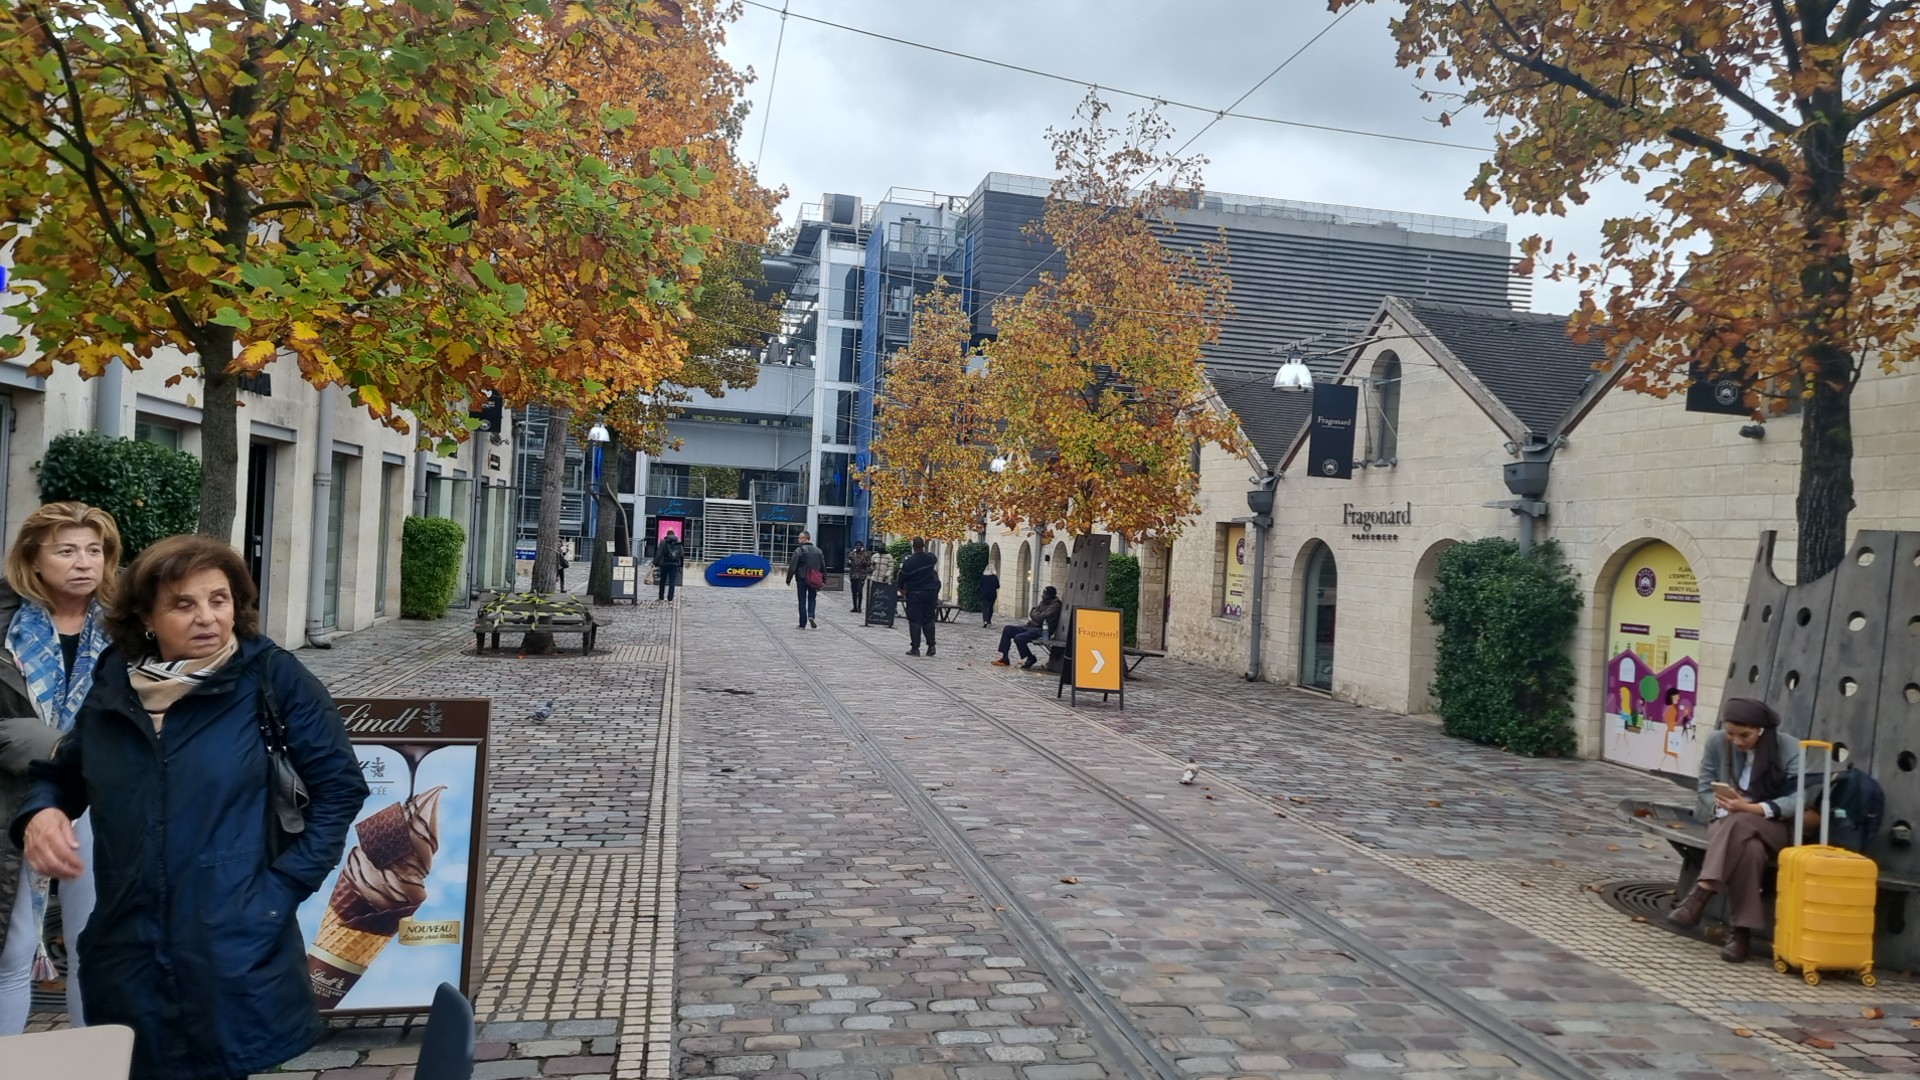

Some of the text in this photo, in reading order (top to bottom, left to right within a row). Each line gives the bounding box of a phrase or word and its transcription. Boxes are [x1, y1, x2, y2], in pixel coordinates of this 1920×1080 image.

[1318, 415, 1351, 426] Fragonard
[1342, 501, 1411, 532] Fragonard
[746, 568, 764, 576] CITÉ
[1078, 627, 1119, 638] Fragonard
[337, 703, 422, 733] Lindt
[406, 925, 453, 934] NOUVEAU
[308, 968, 340, 986] Lindt
